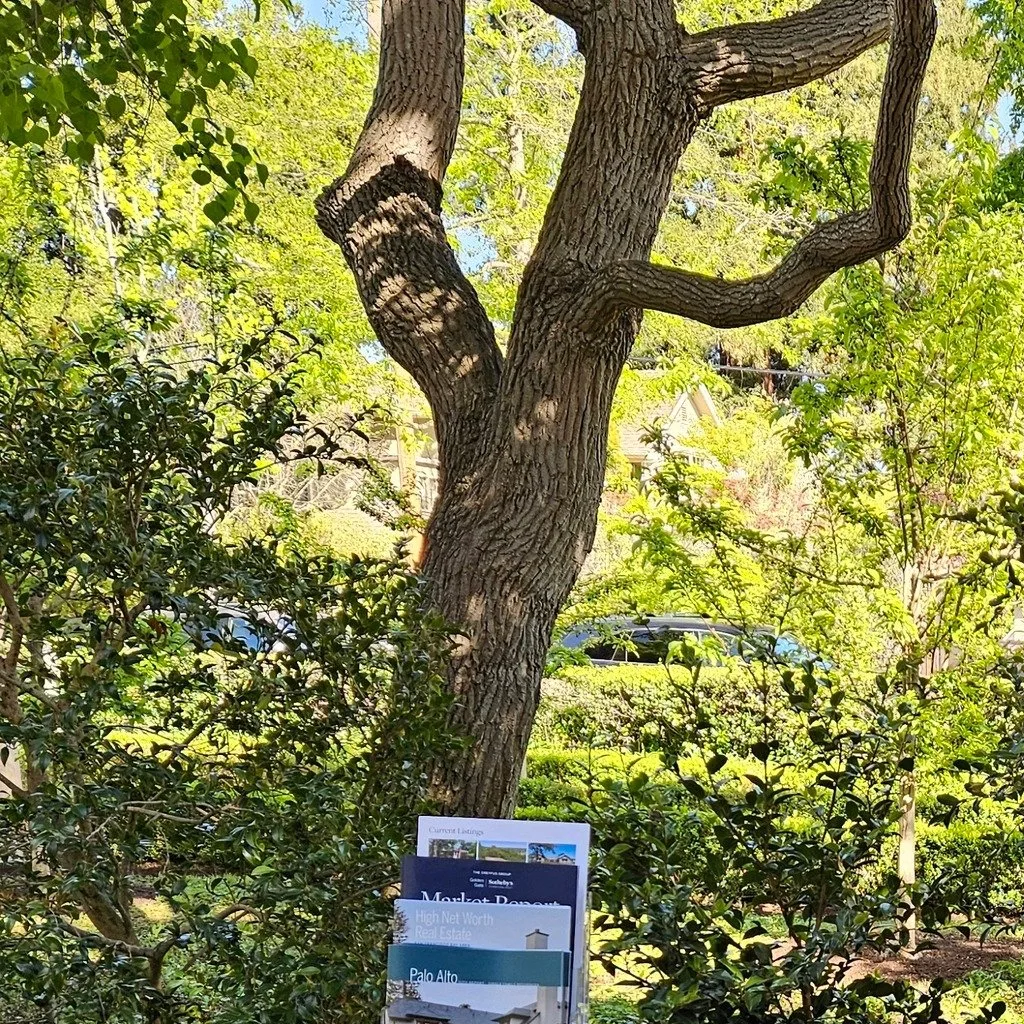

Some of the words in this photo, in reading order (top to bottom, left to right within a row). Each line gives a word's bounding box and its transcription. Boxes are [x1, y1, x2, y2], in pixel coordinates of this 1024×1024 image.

[428, 826, 456, 836] Current
[457, 828, 484, 837] Listings
[415, 910, 440, 927] High
[441, 911, 460, 926] Net
[462, 911, 494, 926] Worth
[415, 925, 437, 940] Real
[440, 927, 472, 941] Estate
[409, 967, 434, 983] Palo
[436, 969, 458, 984] Alto
